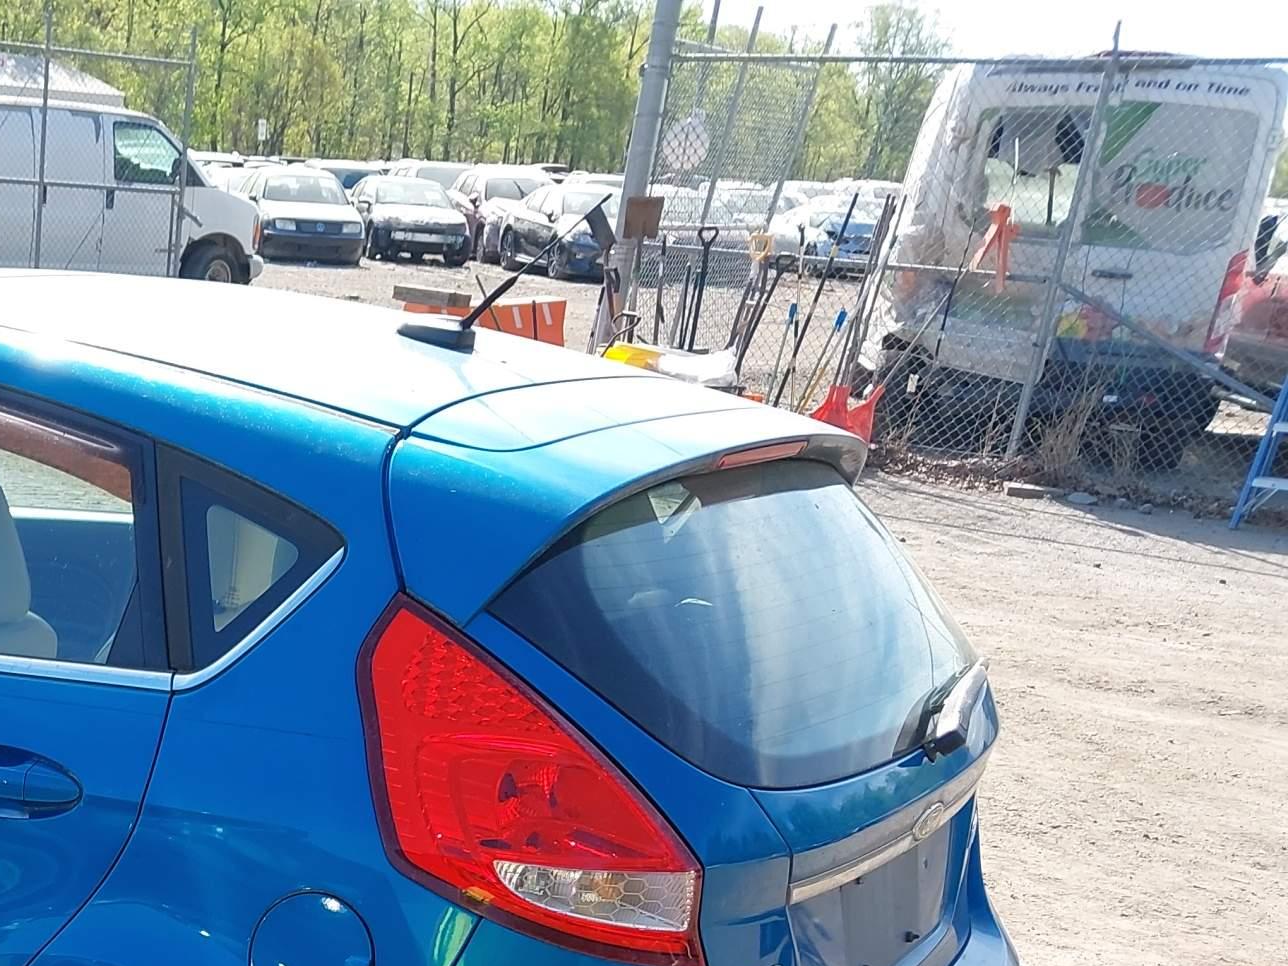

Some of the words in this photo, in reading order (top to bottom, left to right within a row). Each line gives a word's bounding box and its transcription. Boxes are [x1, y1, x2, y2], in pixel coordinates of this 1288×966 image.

[1135, 79, 1171, 89] and
[1175, 82, 1200, 92] on
[1208, 82, 1252, 96] Time
